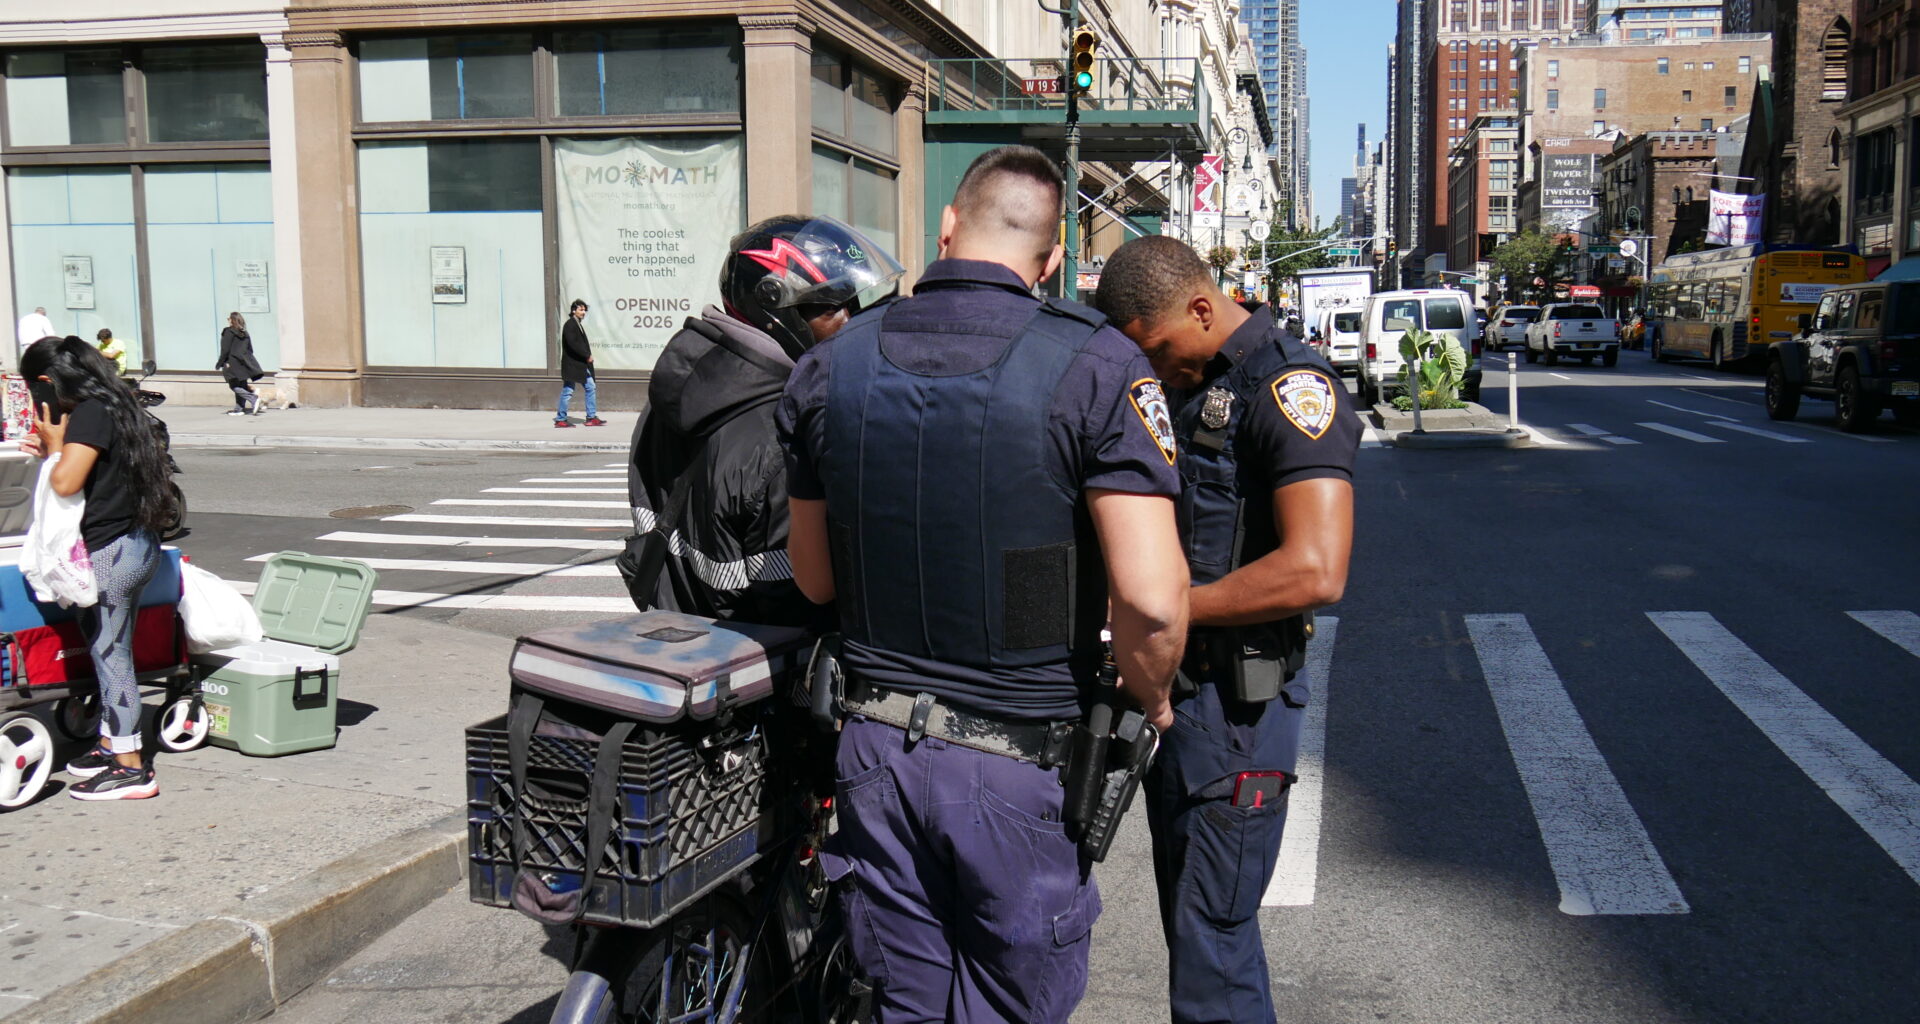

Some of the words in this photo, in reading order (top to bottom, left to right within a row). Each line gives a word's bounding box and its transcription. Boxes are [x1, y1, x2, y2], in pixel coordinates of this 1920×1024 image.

[1025, 80, 1034, 92] W
[1038, 80, 1048, 92] 19
[585, 166, 621, 185] MO
[649, 166, 718, 185] MATH
[1552, 170, 1582, 178] PAPER
[1544, 188, 1575, 196] TWINE
[623, 202, 676, 211] momath.org
[617, 228, 640, 239] The
[643, 228, 685, 239] coolest
[623, 241, 652, 252] thing
[656, 241, 680, 251] that
[608, 255, 633, 265] ever
[636, 254, 696, 266] happened
[627, 267, 640, 277] to
[643, 266, 676, 277] math!
[615, 298, 691, 312] OPENING
[633, 315, 673, 328] 2026
[1287, 374, 1317, 384] POLICE
[1279, 380, 1328, 396] DEPARTMENT
[1283, 402, 1299, 418] CITY
[1296, 417, 1309, 428] OF
